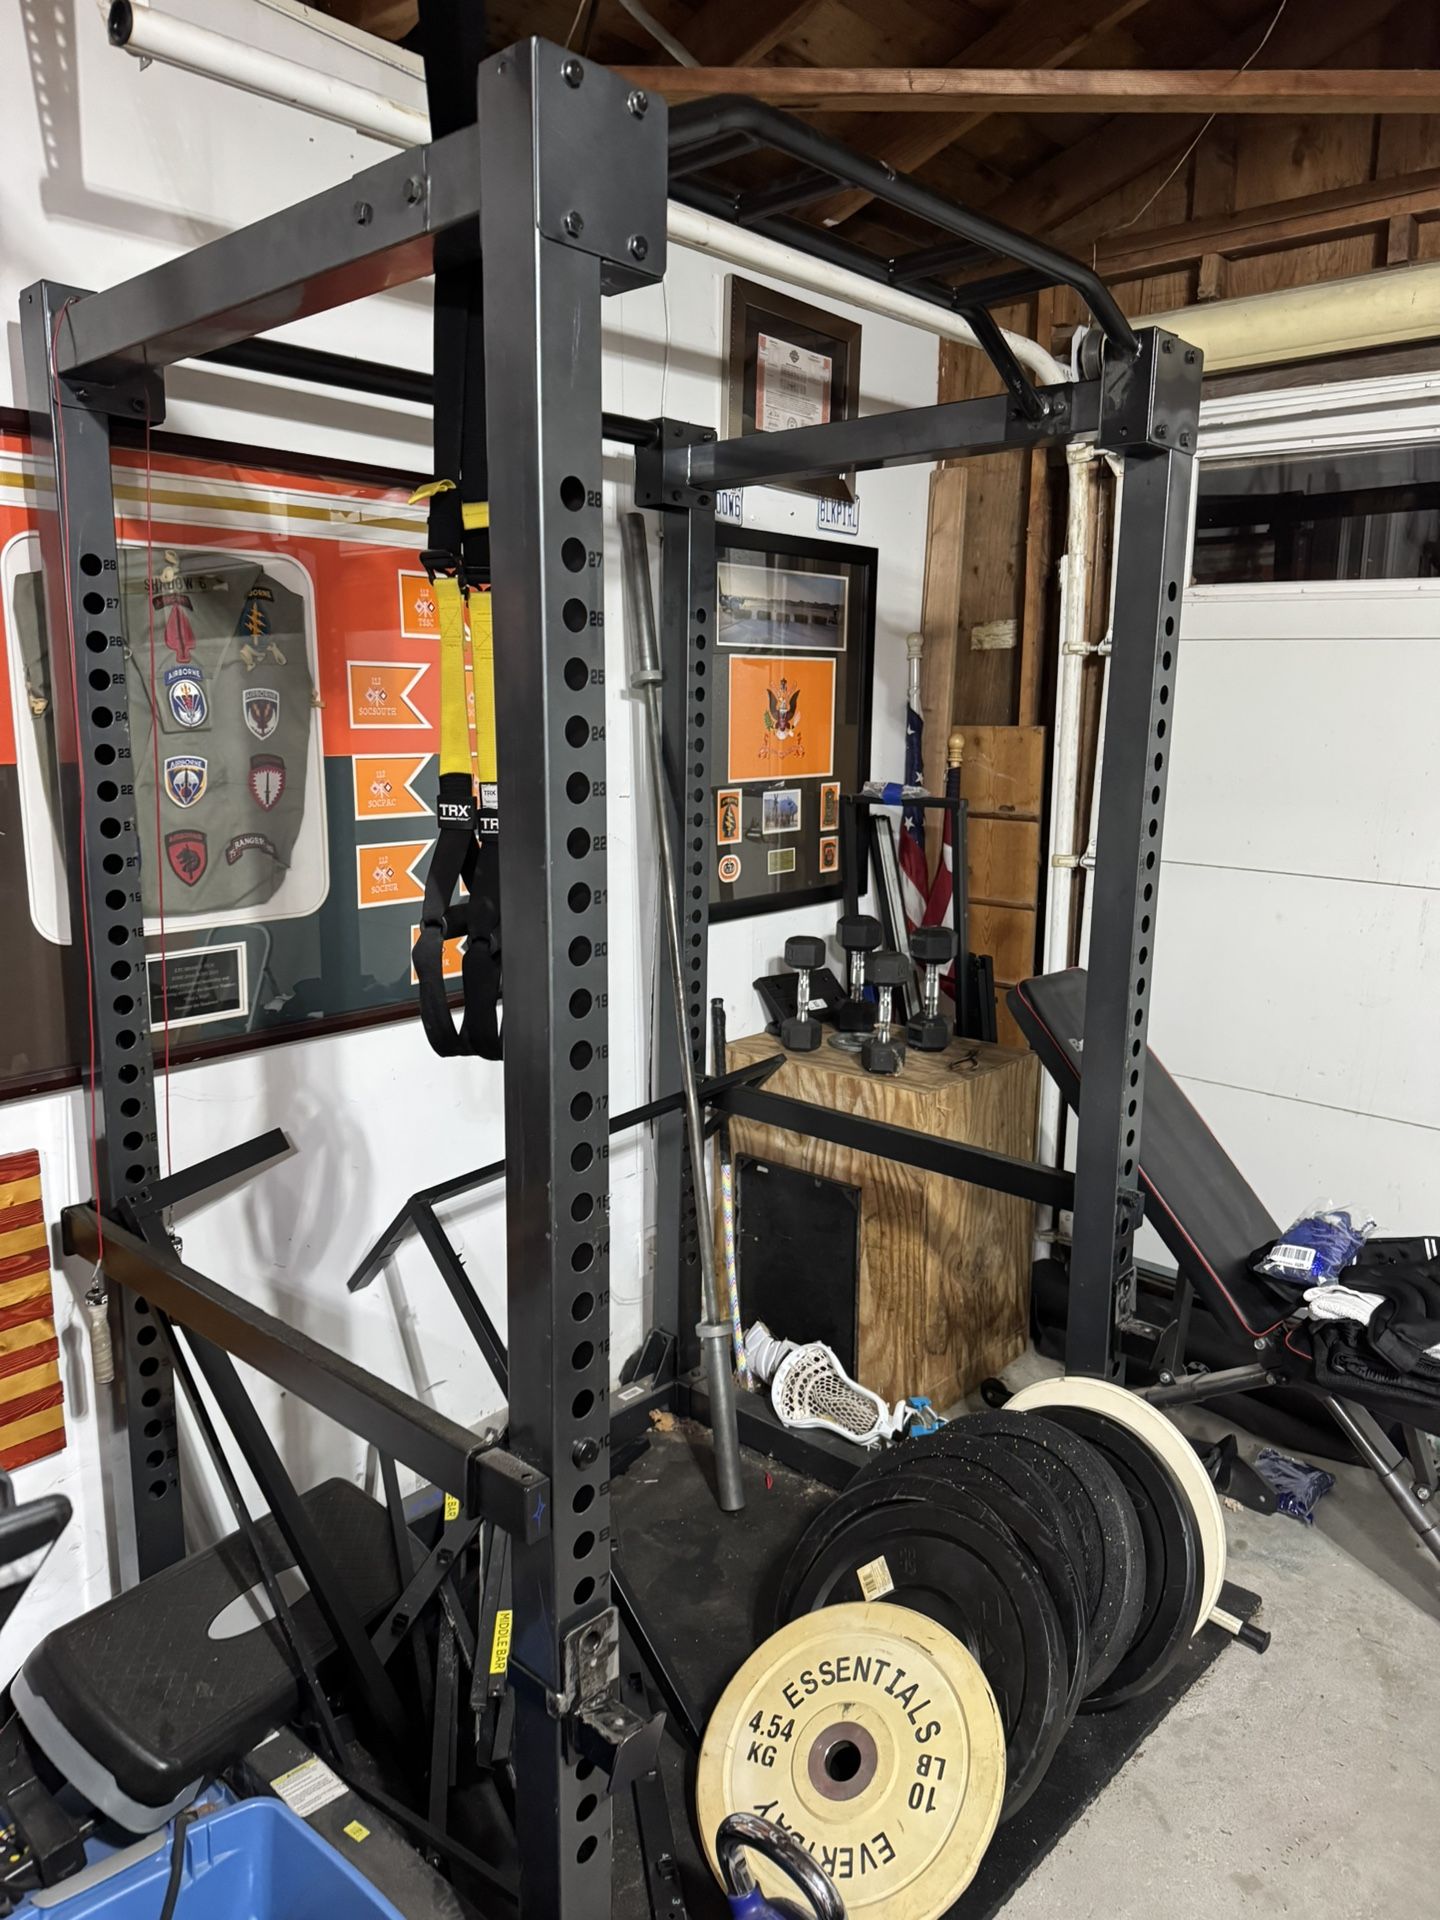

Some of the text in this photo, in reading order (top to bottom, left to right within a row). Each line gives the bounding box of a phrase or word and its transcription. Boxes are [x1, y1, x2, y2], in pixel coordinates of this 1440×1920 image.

[587, 490, 602, 508] 28
[103, 560, 116, 570] 28
[588, 551, 603, 568] 27
[106, 599, 119, 609] 27
[589, 610, 604, 627] 26
[109, 636, 123, 647] 26
[112, 674, 125, 684] 25
[168, 667, 201, 680] AIRBORNE
[590, 669, 605, 685] 25
[115, 711, 128, 722] 24
[358, 707, 397, 716] SOCSOUTH
[591, 726, 606, 741] 24
[118, 748, 131, 758] 23
[170, 759, 202, 769] AIRBORNE
[121, 785, 133, 795] 22
[592, 782, 606, 796] 23
[367, 798, 396, 809] SOCPAC
[439, 803, 469, 817] TRX
[480, 817, 499, 830] TR
[234, 837, 265, 849] RANGER
[593, 836, 607, 851] 22
[370, 882, 398, 894] SOCEUR
[594, 942, 608, 957] 20
[595, 993, 608, 1009] 19
[595, 1045, 608, 1059] 18
[596, 1095, 608, 1111] 17
[598, 1338, 610, 1353] 12
[599, 1527, 610, 1542] 8
[494, 1612, 510, 1670] MIDDLE BAR
[782, 1656, 941, 1743] ESSENTIALS
[749, 1710, 795, 1742] 4.54
[747, 1741, 777, 1767] KG
[908, 1754, 946, 1813] 10 LB
